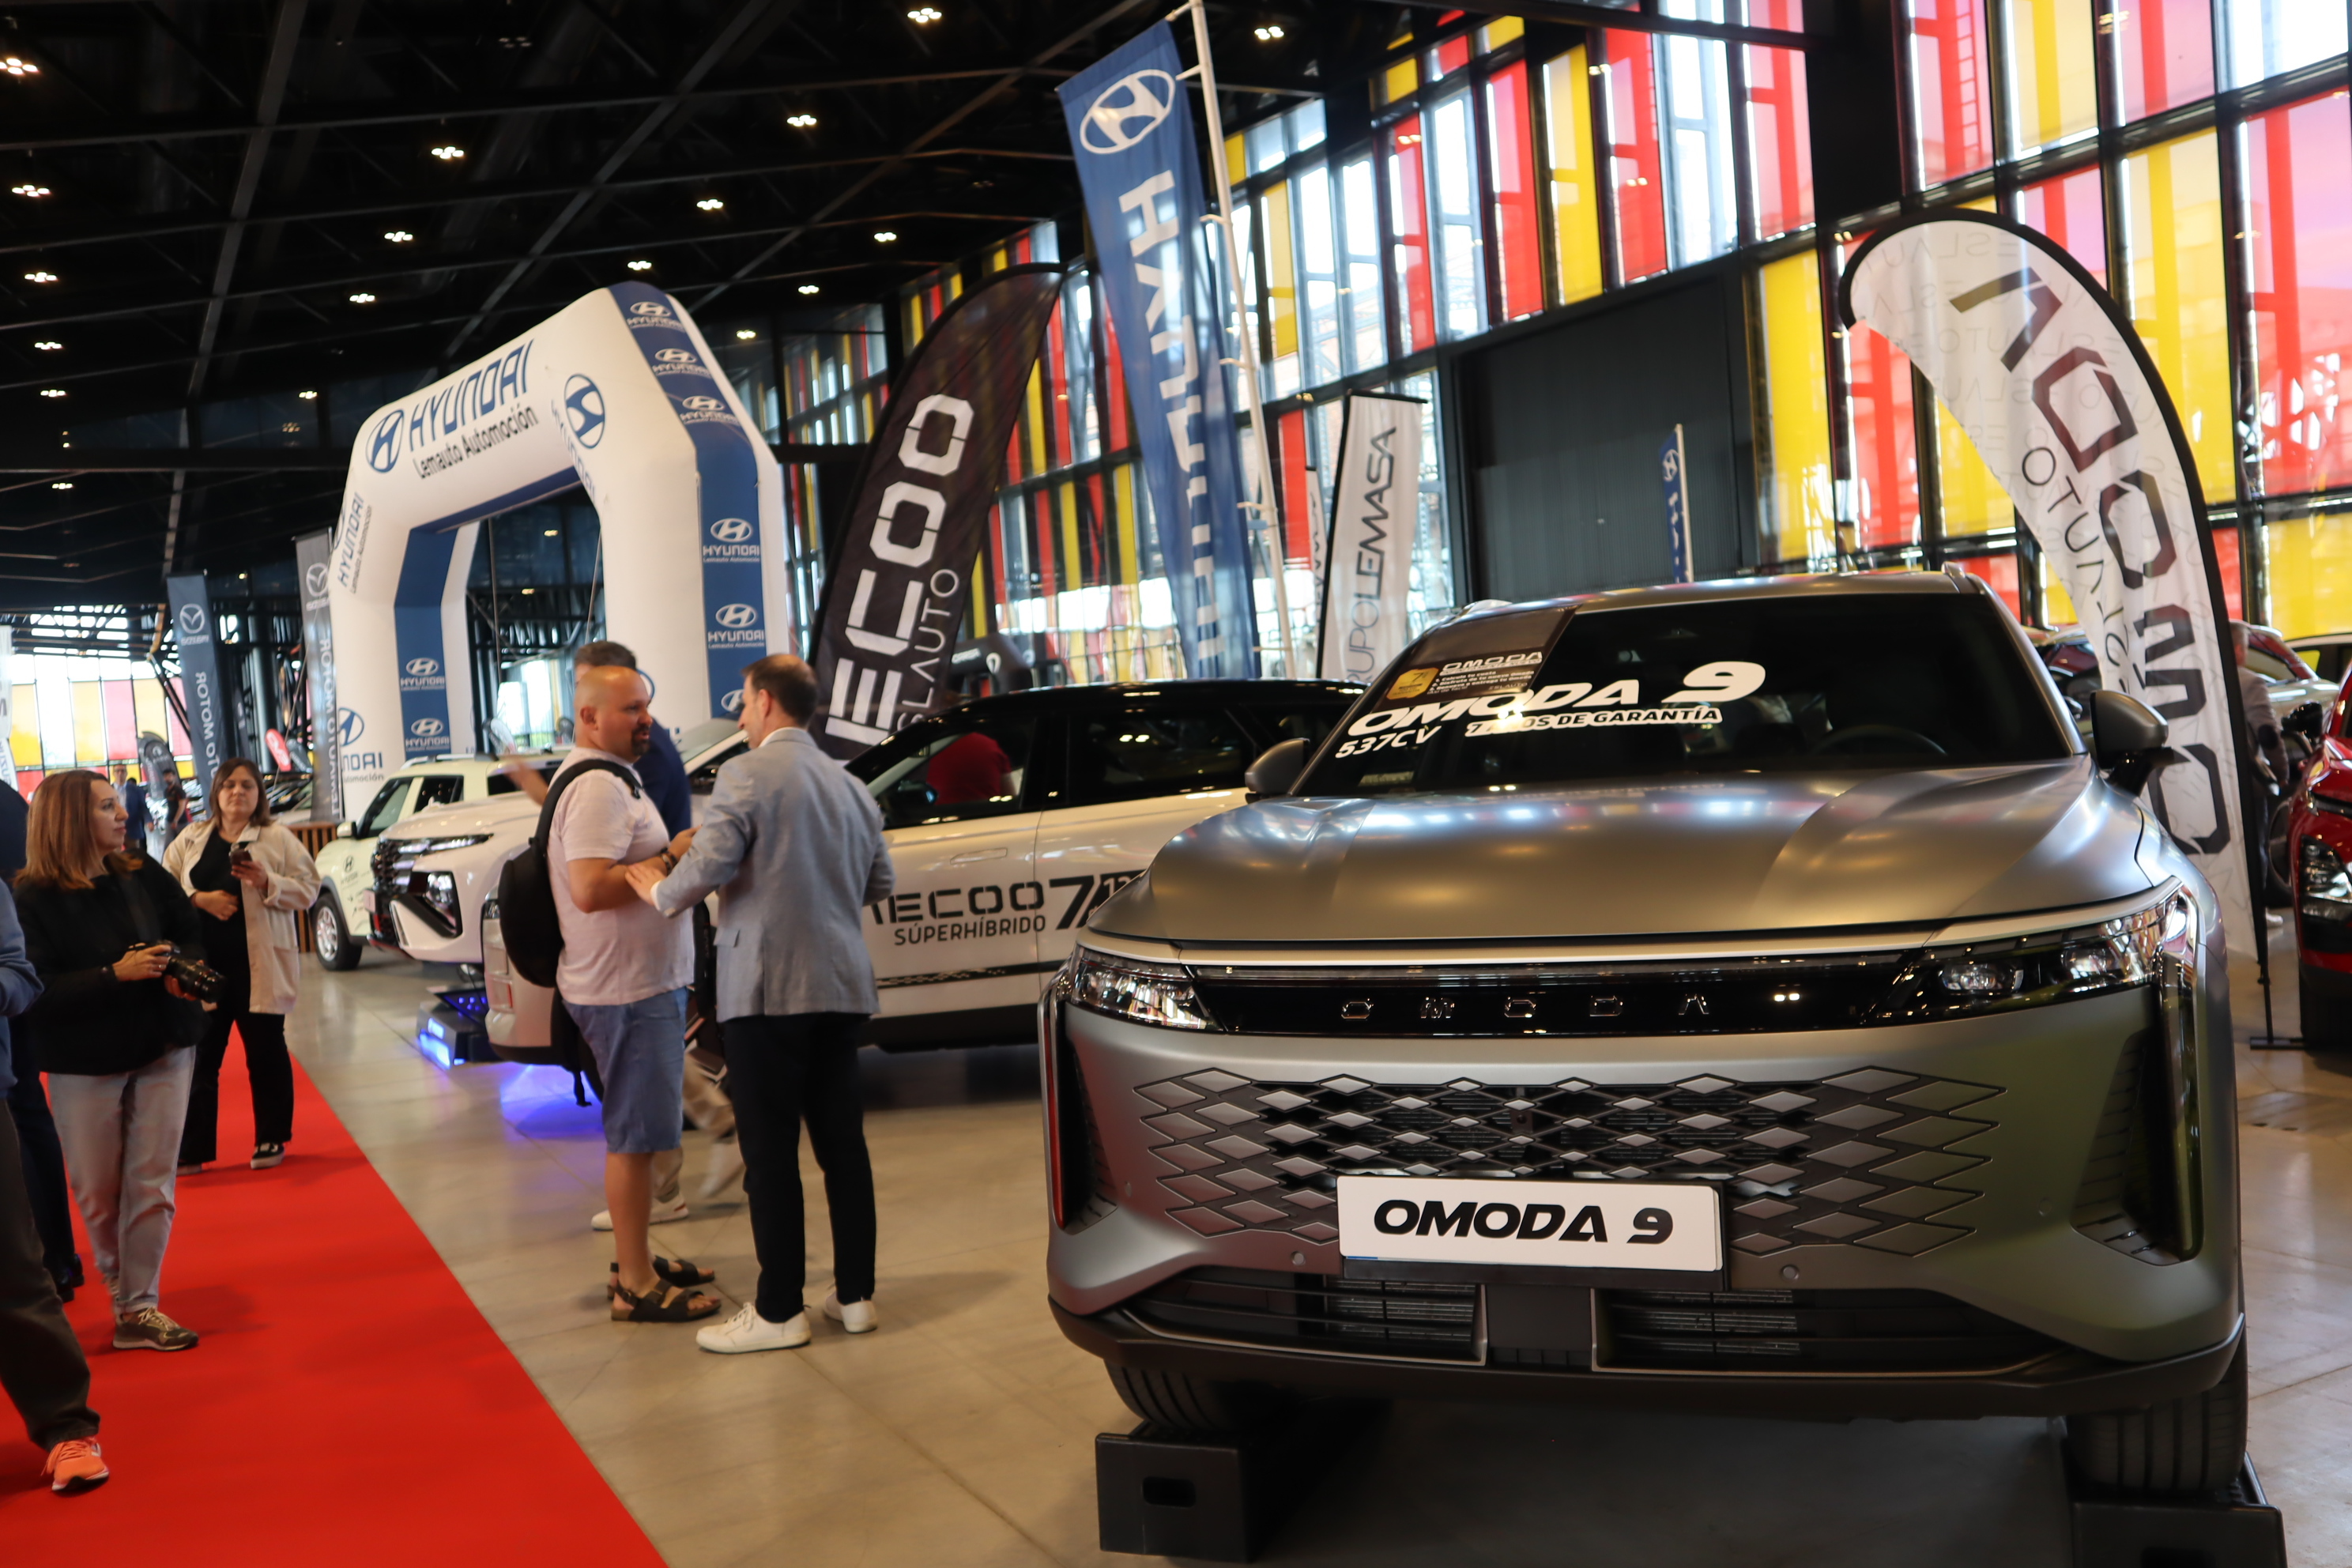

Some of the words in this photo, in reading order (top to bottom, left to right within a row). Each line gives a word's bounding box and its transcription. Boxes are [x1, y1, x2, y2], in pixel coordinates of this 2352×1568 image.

[409, 337, 534, 453] HYUNDAI
[413, 442, 463, 480] Lemauto
[461, 403, 539, 458] Automoción
[1356, 426, 1397, 600] LEMASA
[337, 492, 364, 587] HYUNDAI
[703, 545, 760, 556] HYUNDAI
[825, 394, 974, 747] ECOO
[707, 630, 764, 642] HYUNDAI
[897, 568, 959, 731] SLAUTO
[1442, 651, 1543, 671] OMODA
[400, 676, 445, 686] HYUNDAI
[1348, 680, 1639, 736] OMODA
[1661, 661, 1766, 702] 9
[1470, 723, 1483, 733] 7
[1557, 713, 1587, 726] DE
[1593, 707, 1718, 723] GARANTÍA
[405, 737, 450, 747] HYUNDAI
[1335, 726, 1442, 758] 537CV
[343, 752, 383, 772] NDAI
[894, 914, 1046, 946] SÚPERHÍBRIDO
[1374, 1200, 1608, 1242] OMODA
[1626, 1207, 1673, 1244] 9
